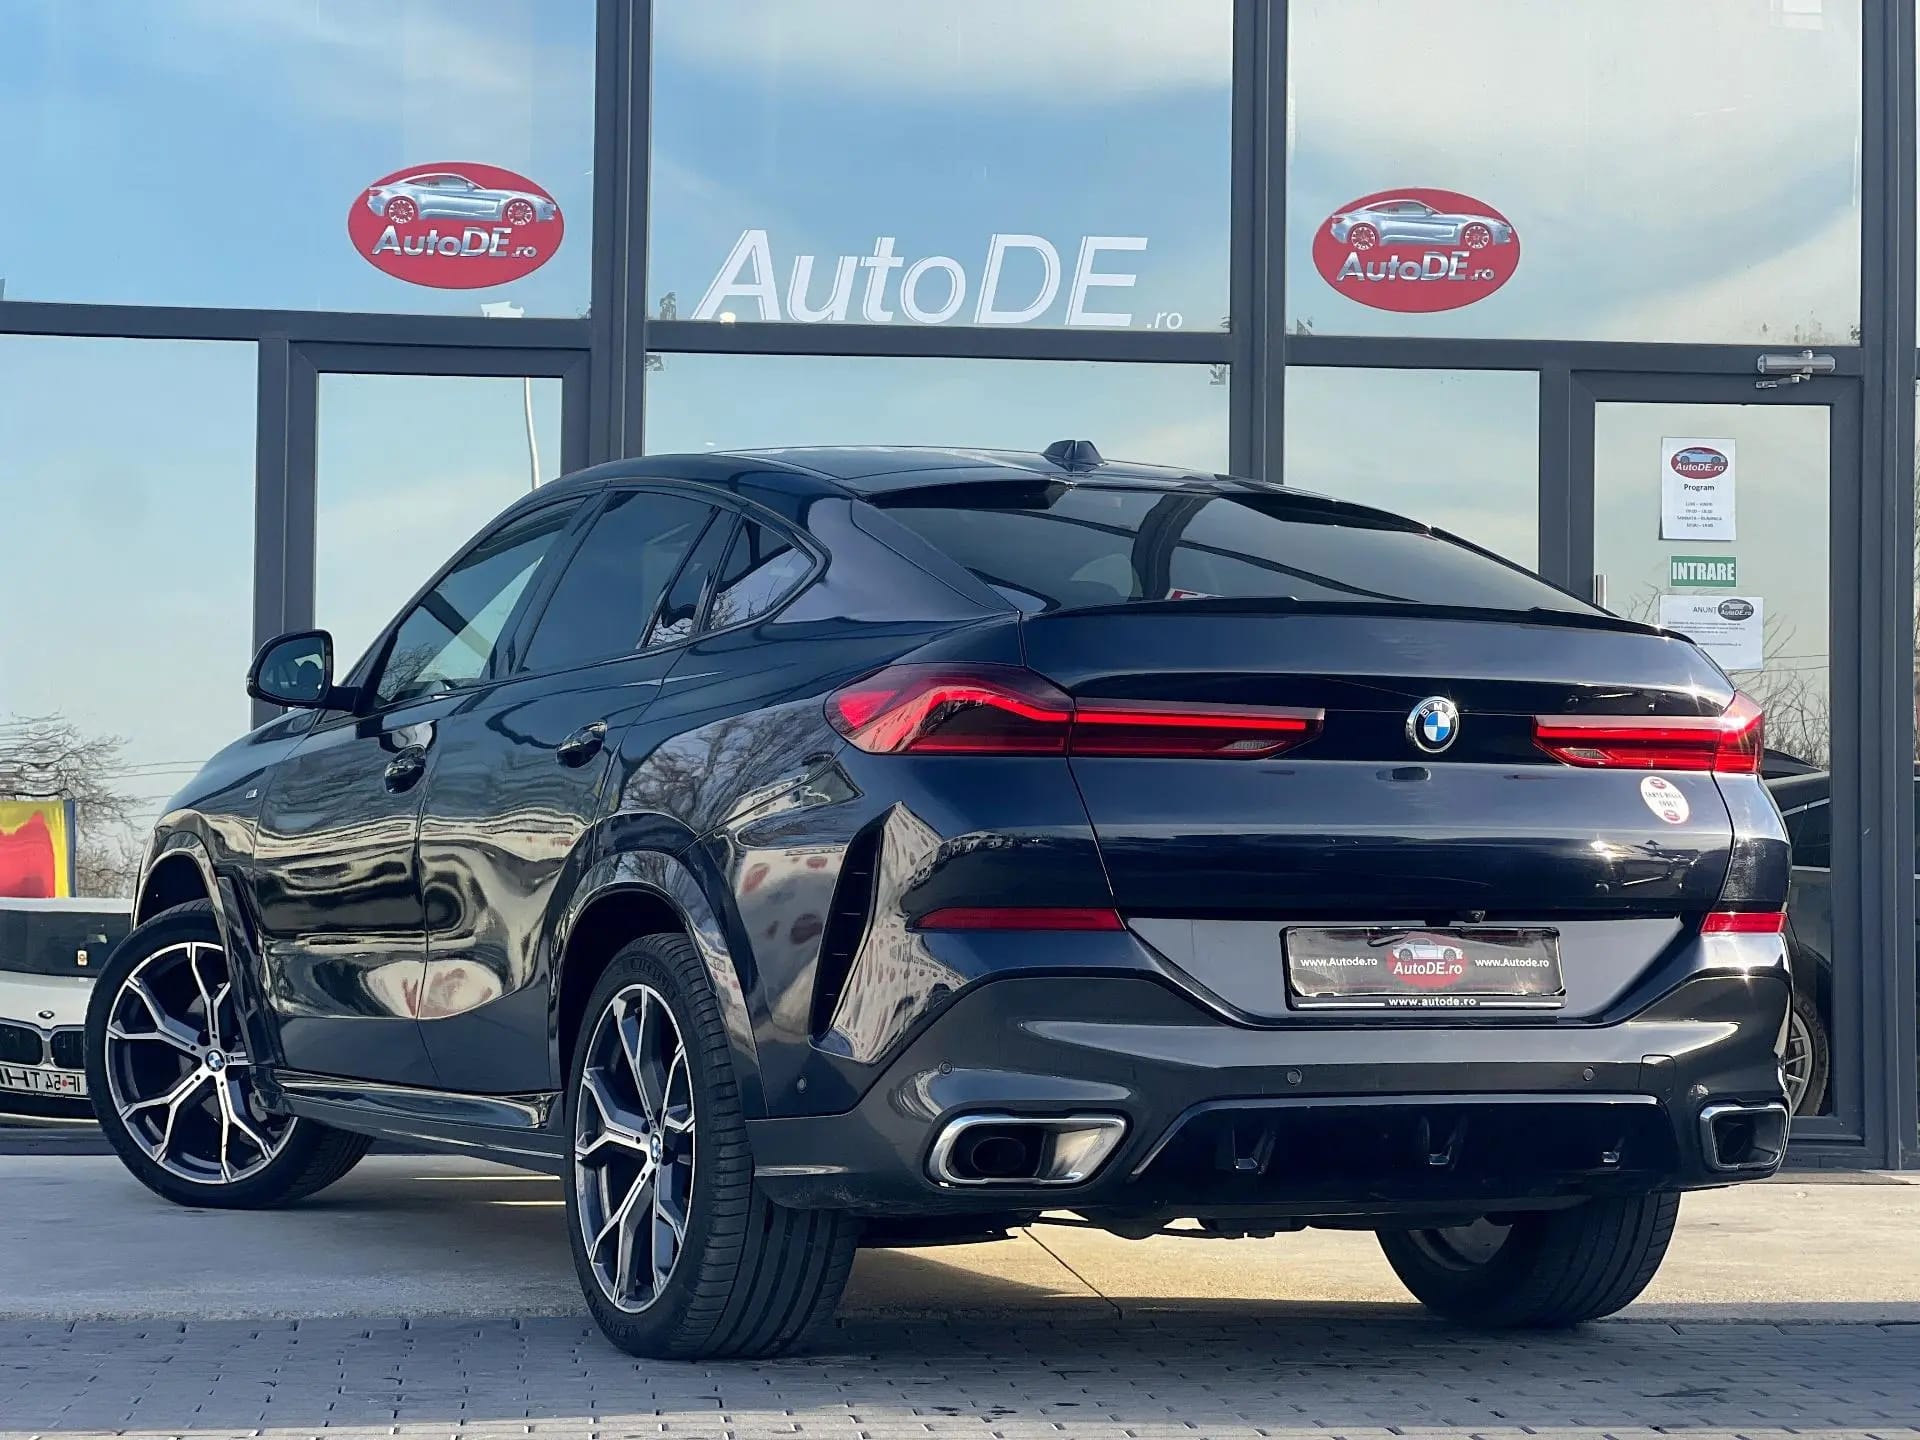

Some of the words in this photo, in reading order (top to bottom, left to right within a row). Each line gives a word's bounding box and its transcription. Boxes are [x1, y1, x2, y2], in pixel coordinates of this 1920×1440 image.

[1675, 463, 1724, 472] AutoDE.ro
[1672, 562, 1735, 581] INTRARE
[1300, 957, 1378, 967] www.Autode.ro
[1475, 957, 1550, 968] www.Autode.ro
[1393, 961, 1463, 975] AutoDE.ro
[1388, 998, 1477, 1006] www.autode.ro
